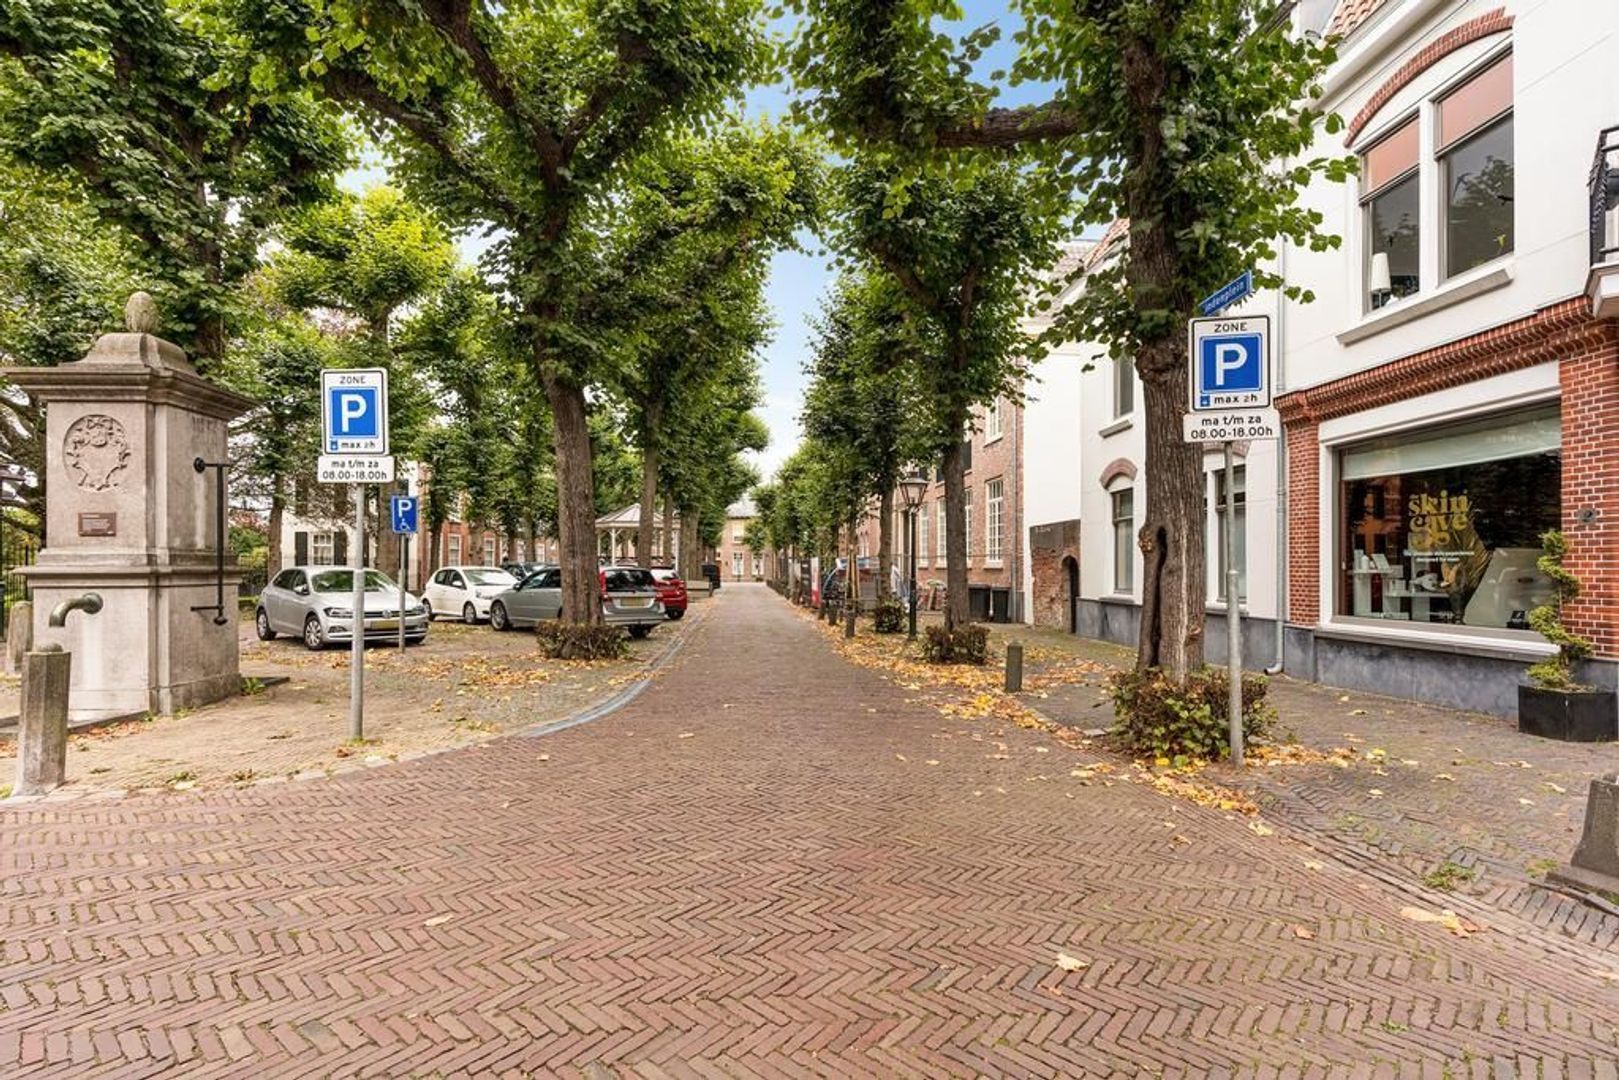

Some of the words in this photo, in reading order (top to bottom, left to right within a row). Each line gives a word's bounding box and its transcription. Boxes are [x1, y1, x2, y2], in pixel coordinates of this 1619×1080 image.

[1214, 322, 1248, 333] ZONE
[1215, 343, 1248, 386] P
[339, 376, 366, 384] ZONE
[1214, 396, 1239, 404] max
[341, 394, 367, 433] P
[1201, 416, 1219, 427] ma
[1223, 414, 1244, 426] t/m
[1247, 414, 1262, 424] za
[1191, 426, 1273, 440] 08.00-18.00h
[341, 441, 361, 449] max
[331, 460, 346, 468] ma
[348, 459, 365, 468] t/m
[367, 460, 379, 468] za
[322, 470, 387, 480] 08.00-18.00h
[398, 499, 412, 518] P
[1408, 490, 1468, 517] skin
